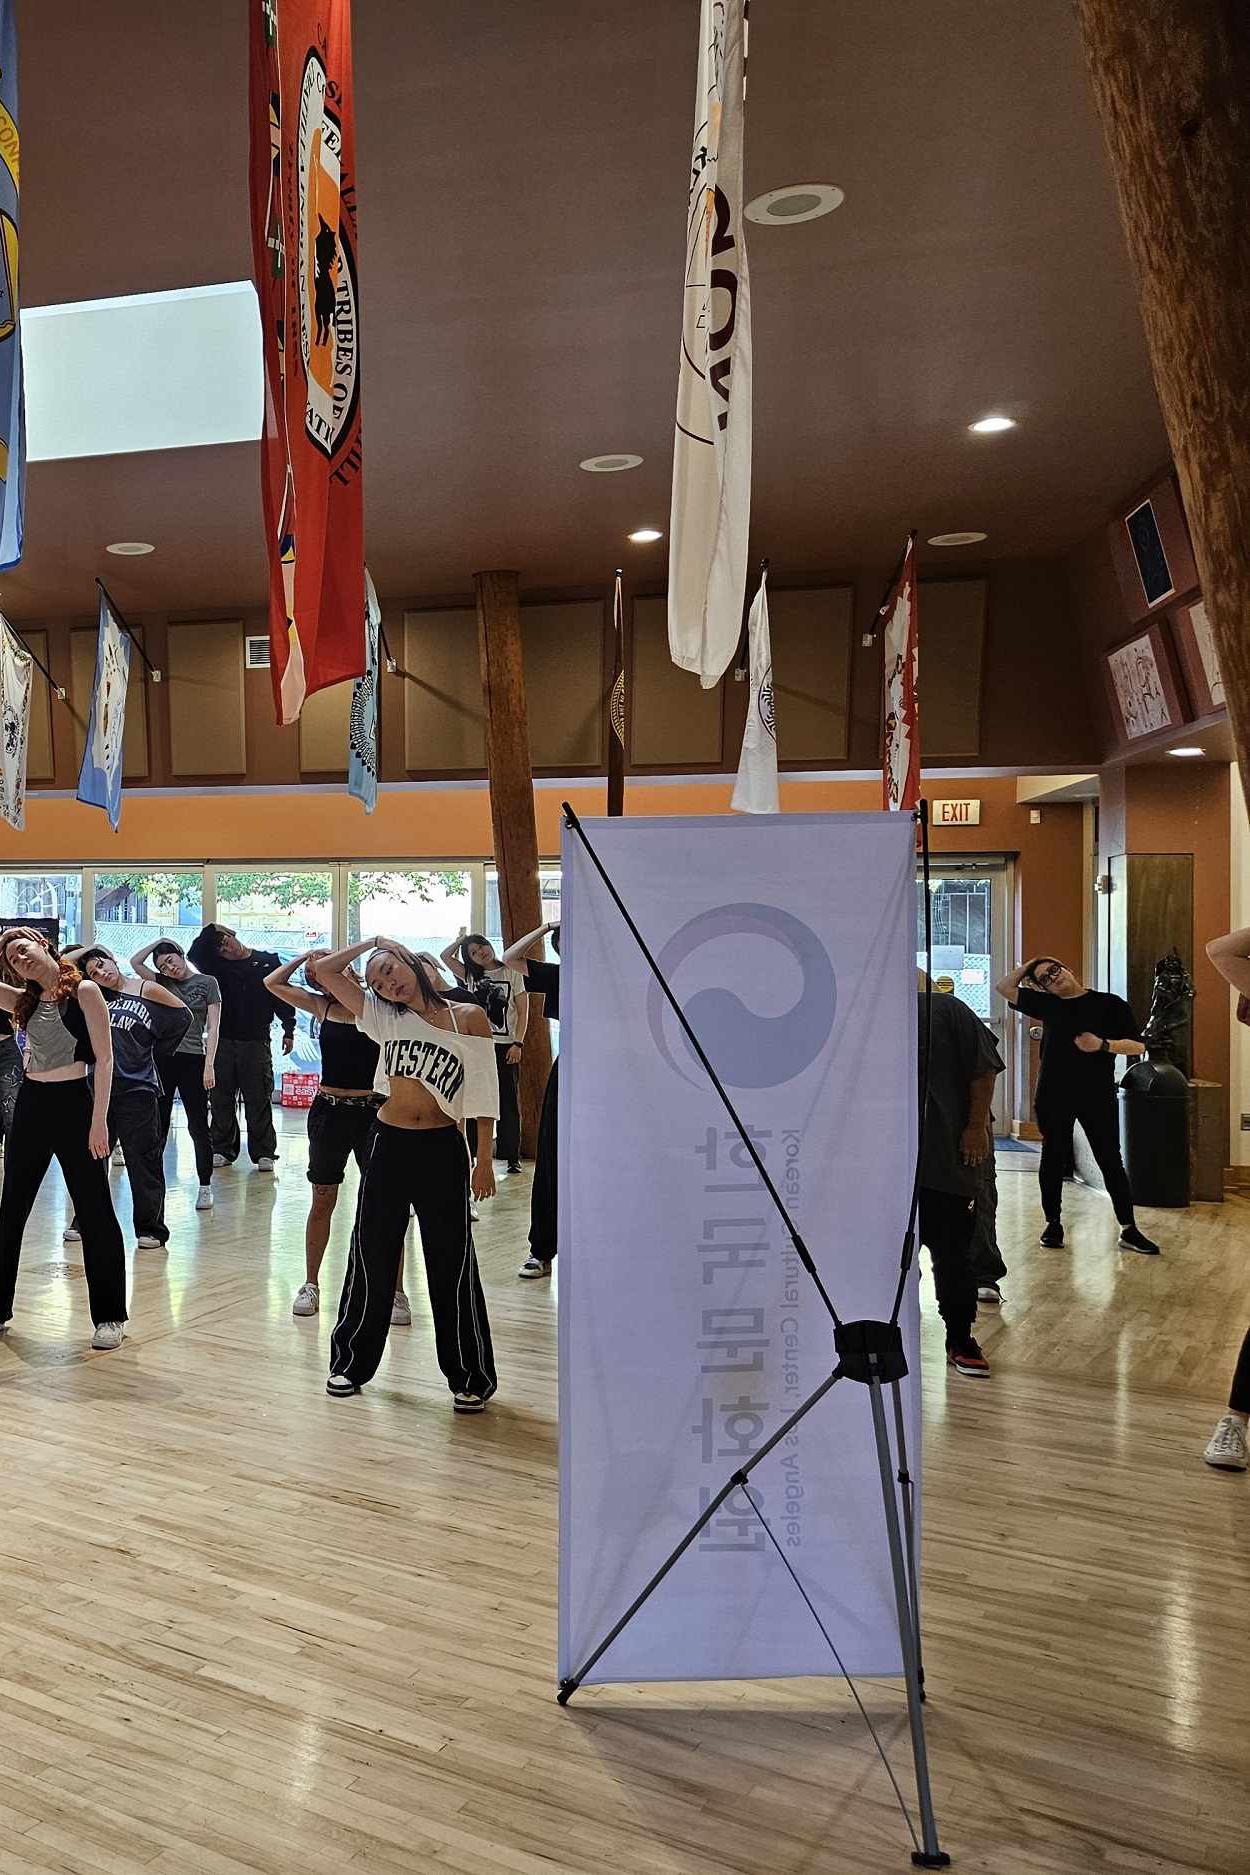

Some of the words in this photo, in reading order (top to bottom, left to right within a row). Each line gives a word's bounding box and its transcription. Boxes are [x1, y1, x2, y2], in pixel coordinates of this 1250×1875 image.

[335, 280, 354, 377] TRIBES
[332, 383, 349, 421] OF
[942, 803, 971, 822] EXIT
[106, 996, 152, 1030] OLUMBIA
[110, 1013, 137, 1032] LAW
[384, 1039, 465, 1104] WESTERN
